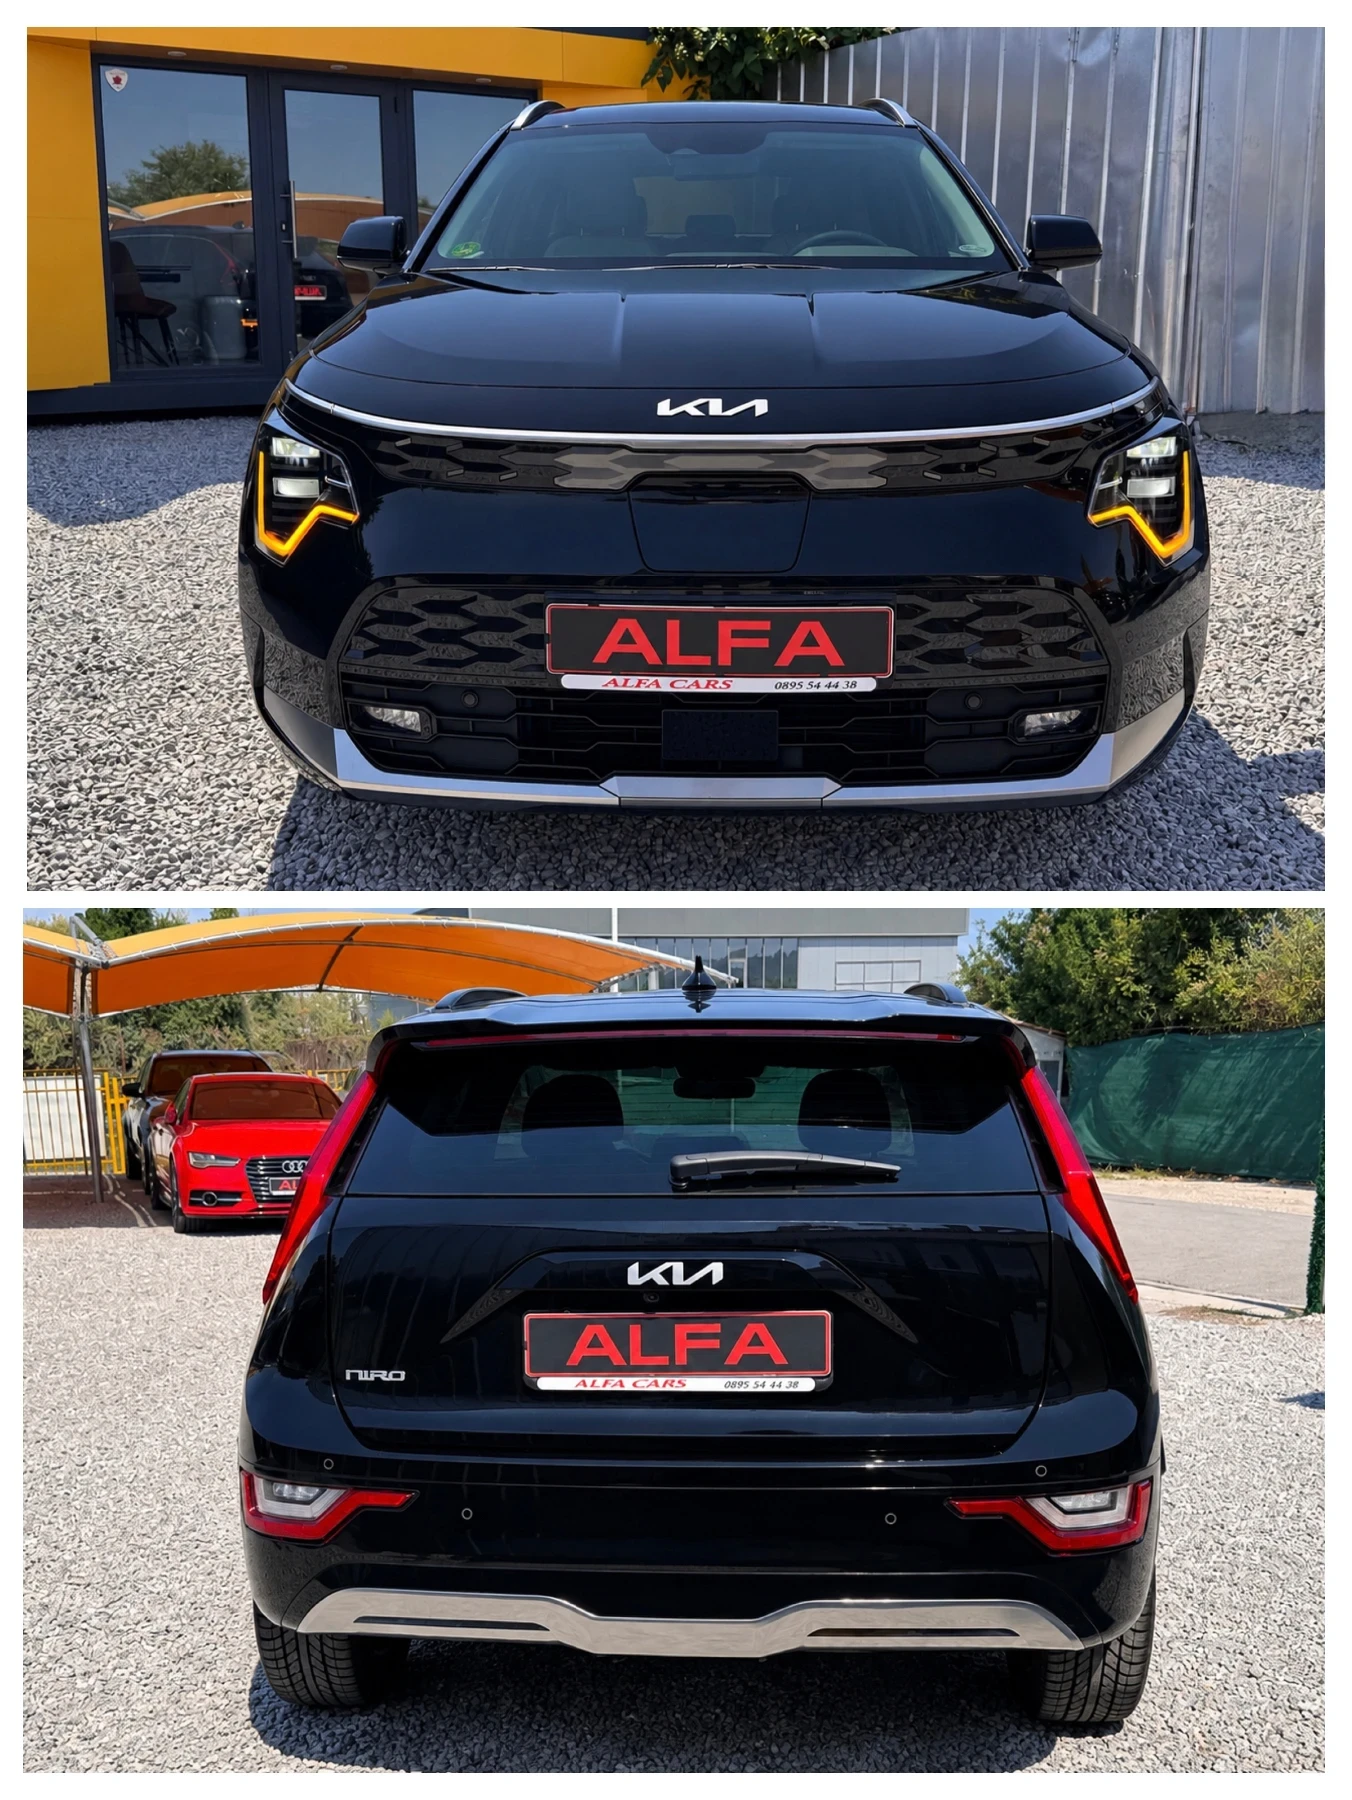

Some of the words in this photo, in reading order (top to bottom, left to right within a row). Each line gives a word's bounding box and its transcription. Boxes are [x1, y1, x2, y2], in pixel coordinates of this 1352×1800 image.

[592, 618, 845, 667] ALFA
[602, 677, 662, 689] ALFA
[669, 679, 733, 690] CARS
[774, 681, 804, 690] 0895
[806, 681, 821, 690] 54
[824, 681, 840, 690] 44
[842, 681, 858, 690] 38
[566, 1322, 789, 1366] ALFA
[575, 1379, 625, 1388] ALFA
[632, 1379, 687, 1388] CARS
[724, 1380, 749, 1389] 0895
[752, 1380, 766, 1389] 54
[769, 1380, 783, 1389] 44
[785, 1380, 800, 1389] 38
